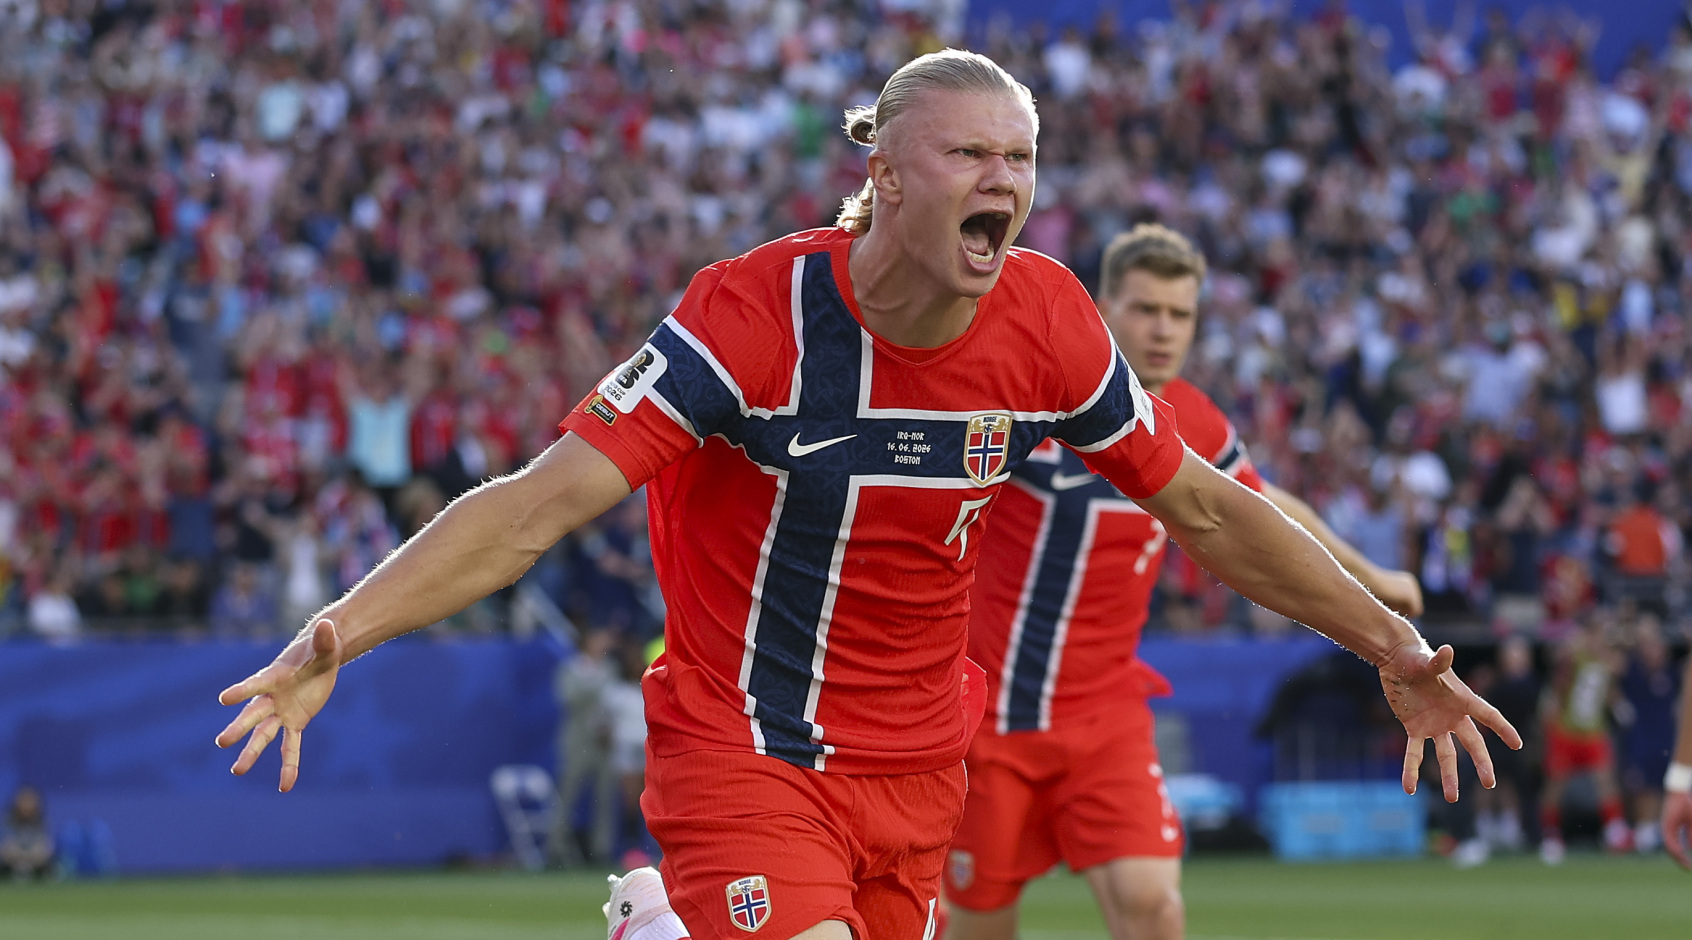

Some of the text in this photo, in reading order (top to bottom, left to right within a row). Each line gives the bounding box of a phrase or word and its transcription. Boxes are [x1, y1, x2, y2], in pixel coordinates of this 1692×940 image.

[604, 384, 622, 401] 2026
[595, 403, 614, 419] DEBUT
[897, 431, 925, 440] IRQ-NOR
[894, 455, 921, 465] BOSTON
